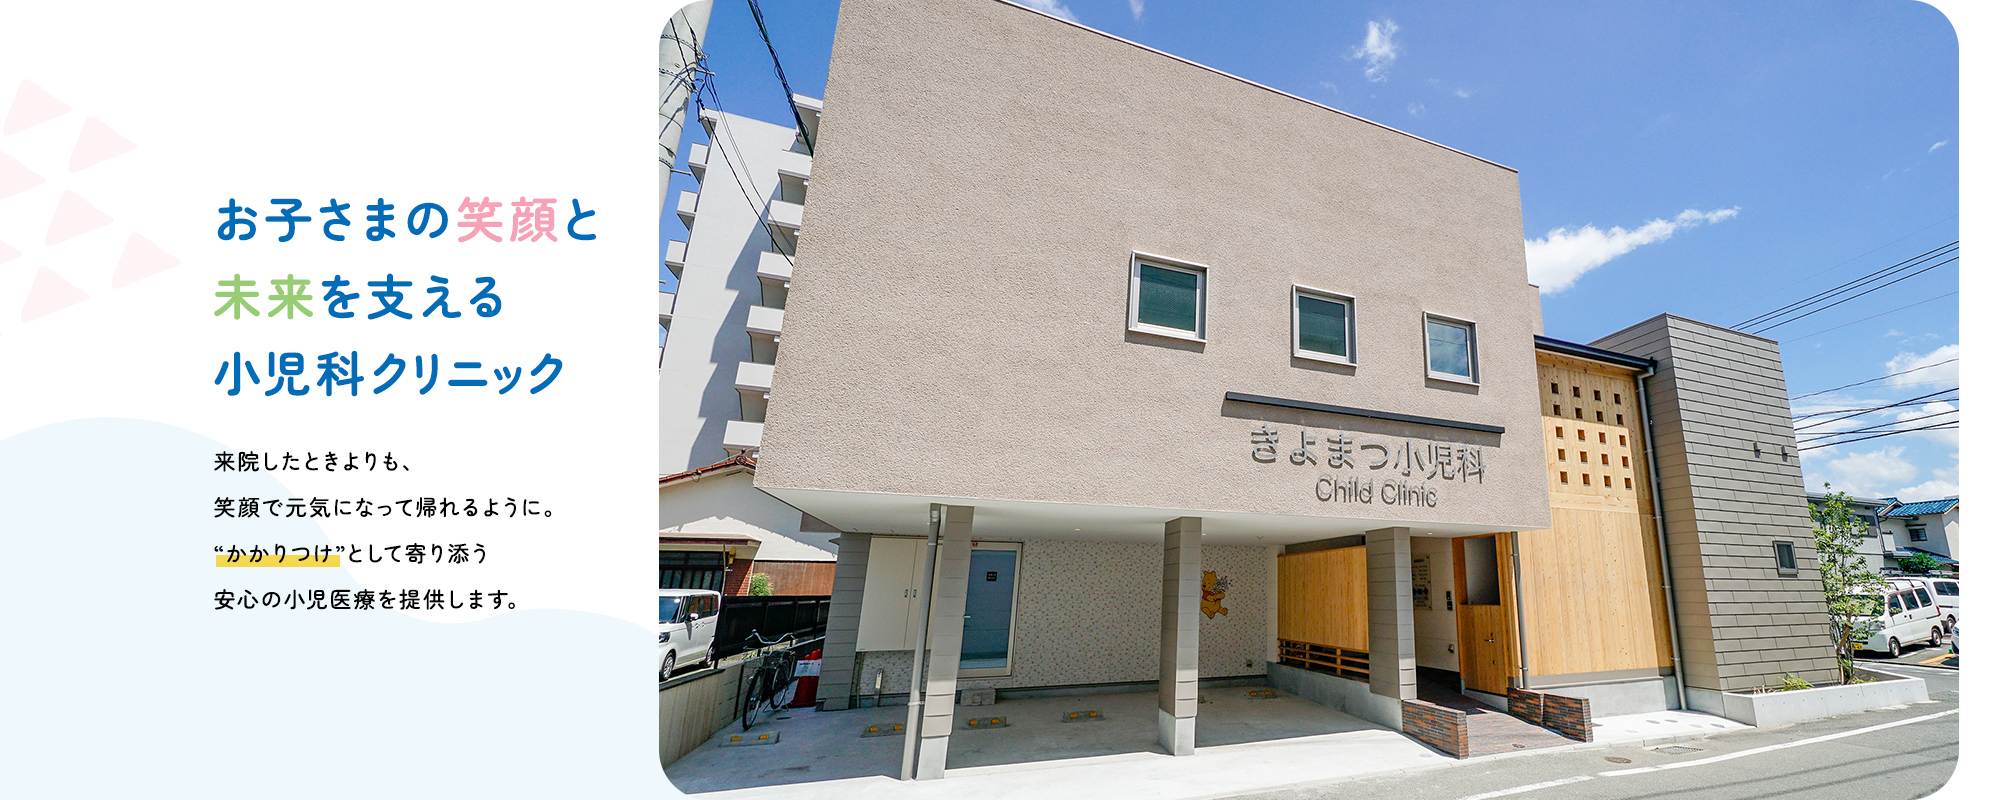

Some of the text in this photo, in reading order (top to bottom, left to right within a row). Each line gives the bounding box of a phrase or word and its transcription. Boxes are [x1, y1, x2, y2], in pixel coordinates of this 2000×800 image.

[1251, 422, 1487, 481] きよまつ小児科
[1316, 473, 1438, 505] Child Clinic
